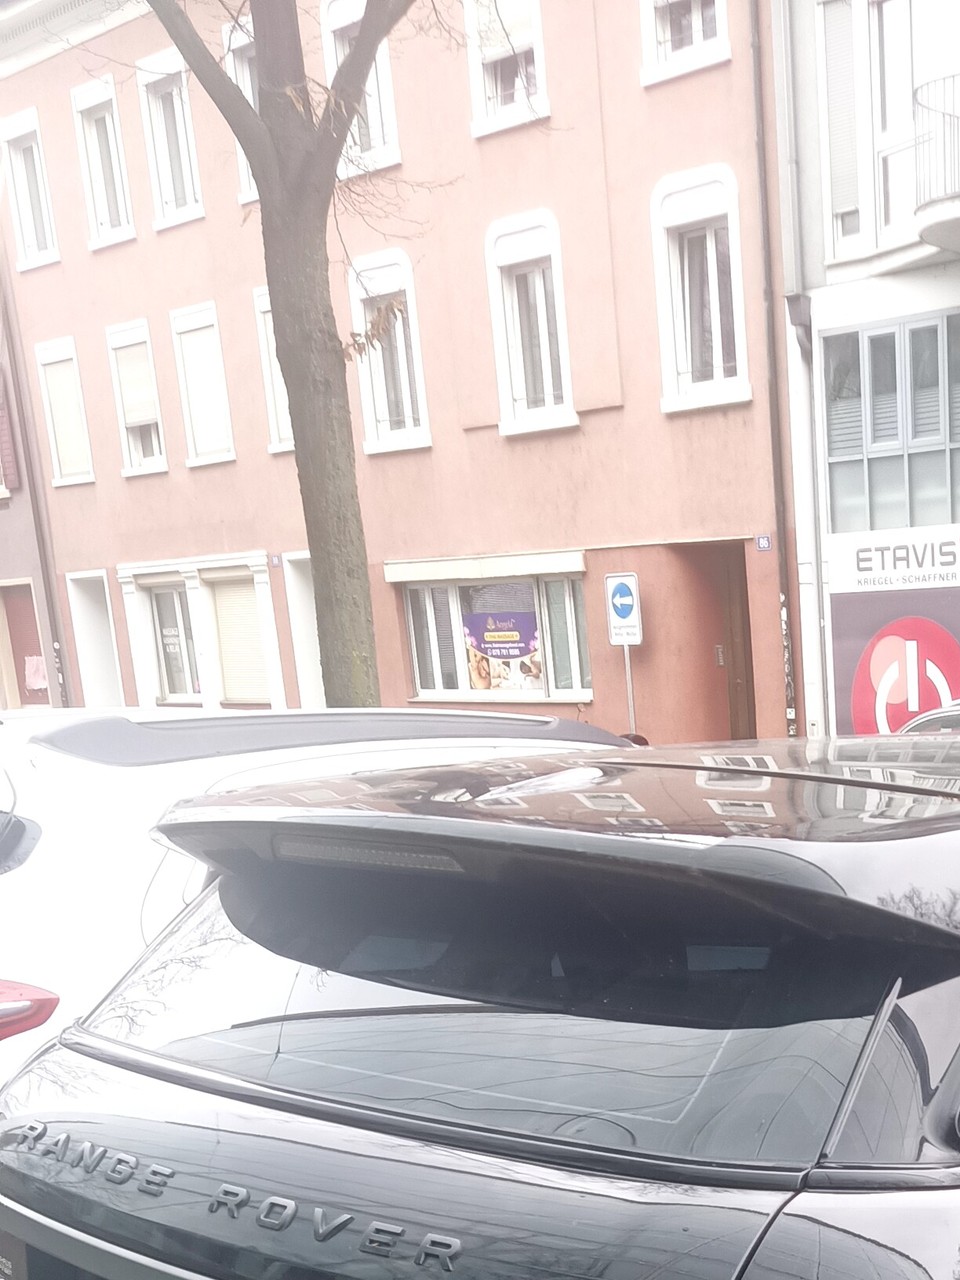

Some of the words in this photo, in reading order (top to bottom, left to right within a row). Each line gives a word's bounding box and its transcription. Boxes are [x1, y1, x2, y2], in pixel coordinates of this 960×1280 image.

[759, 536, 769, 548] 86
[856, 541, 957, 572] ETAVIS
[857, 576, 894, 586] KRIEGEL
[901, 572, 957, 584] SCHAFFNER
[17, 1119, 176, 1197] RANGE
[208, 1183, 462, 1272] ROVER
